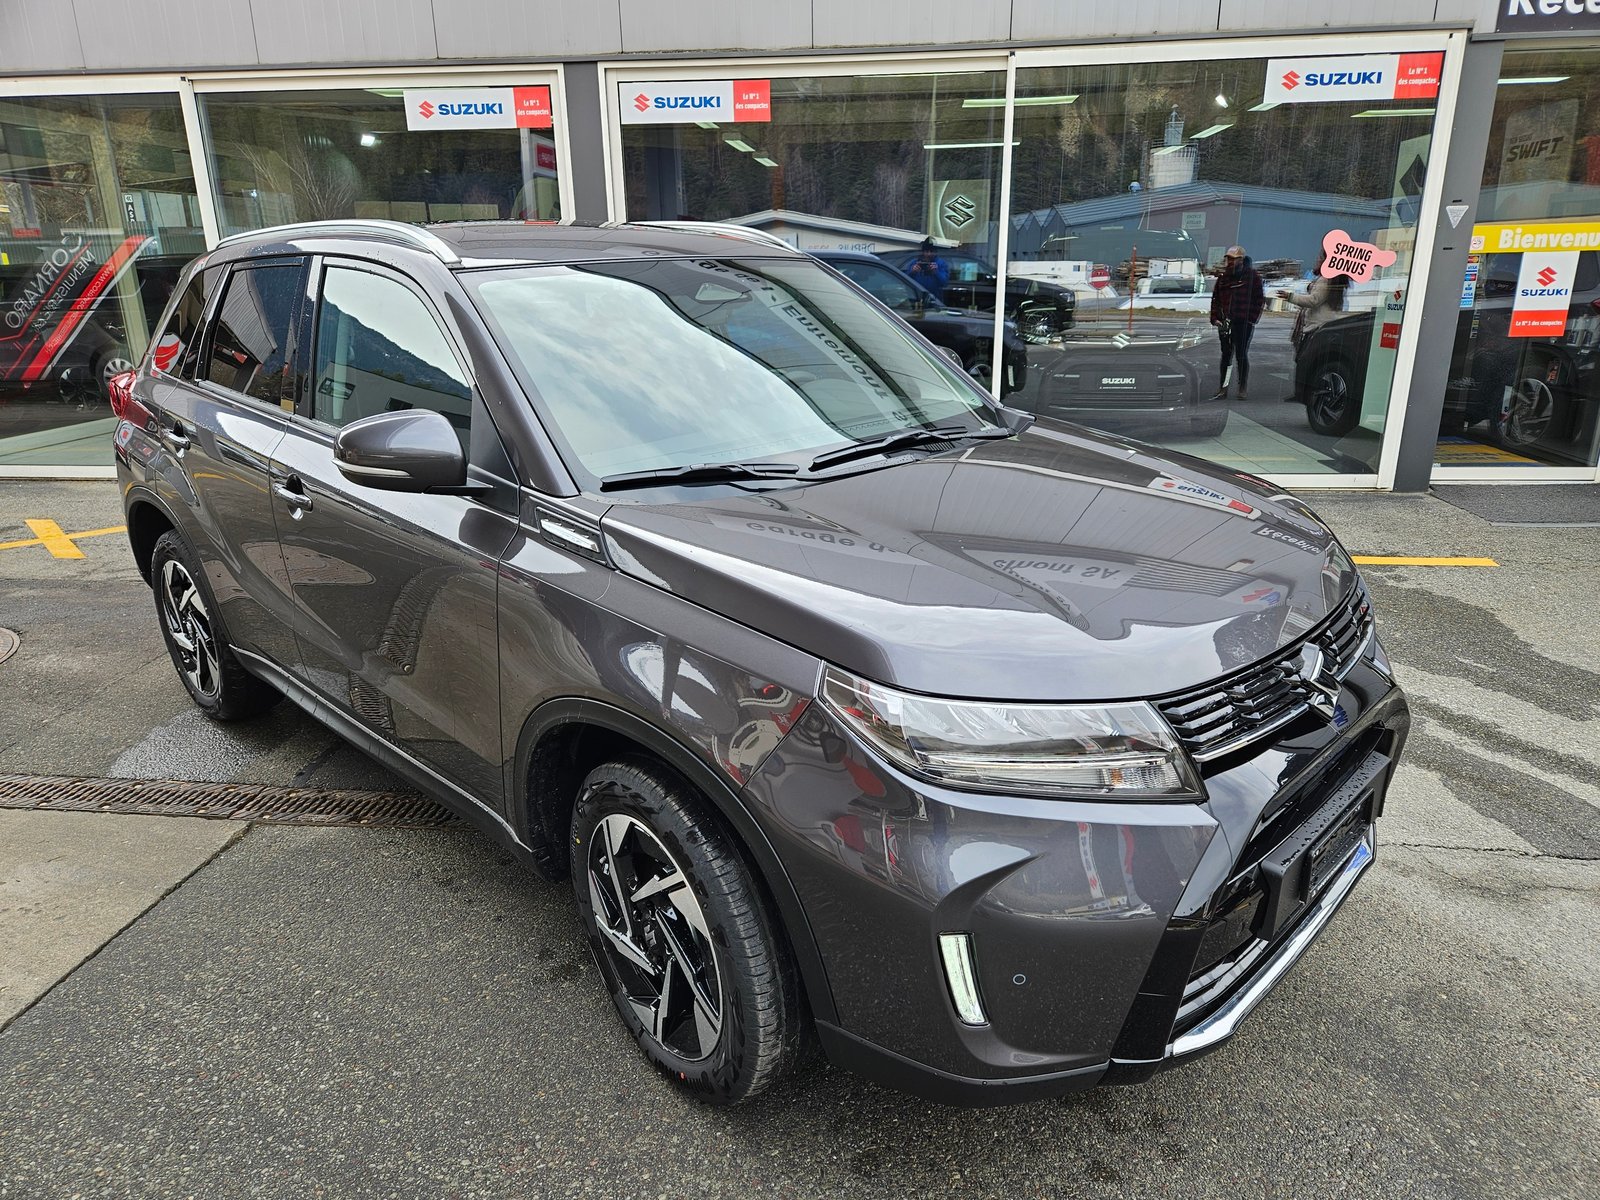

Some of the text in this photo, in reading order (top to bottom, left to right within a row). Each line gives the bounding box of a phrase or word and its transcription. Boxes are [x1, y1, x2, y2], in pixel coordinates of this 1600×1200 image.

[1304, 71, 1383, 87] SUZUKI
[1408, 78, 1437, 86] compactes
[654, 96, 721, 109] SUZUKI
[438, 103, 503, 116] SUZUKI
[1506, 136, 1564, 162] SWIFT
[1333, 242, 1373, 262] SPRING
[1327, 256, 1367, 276] BONUS
[1520, 288, 1568, 297] SUZUKI
[1101, 377, 1136, 385] SUZUKI
